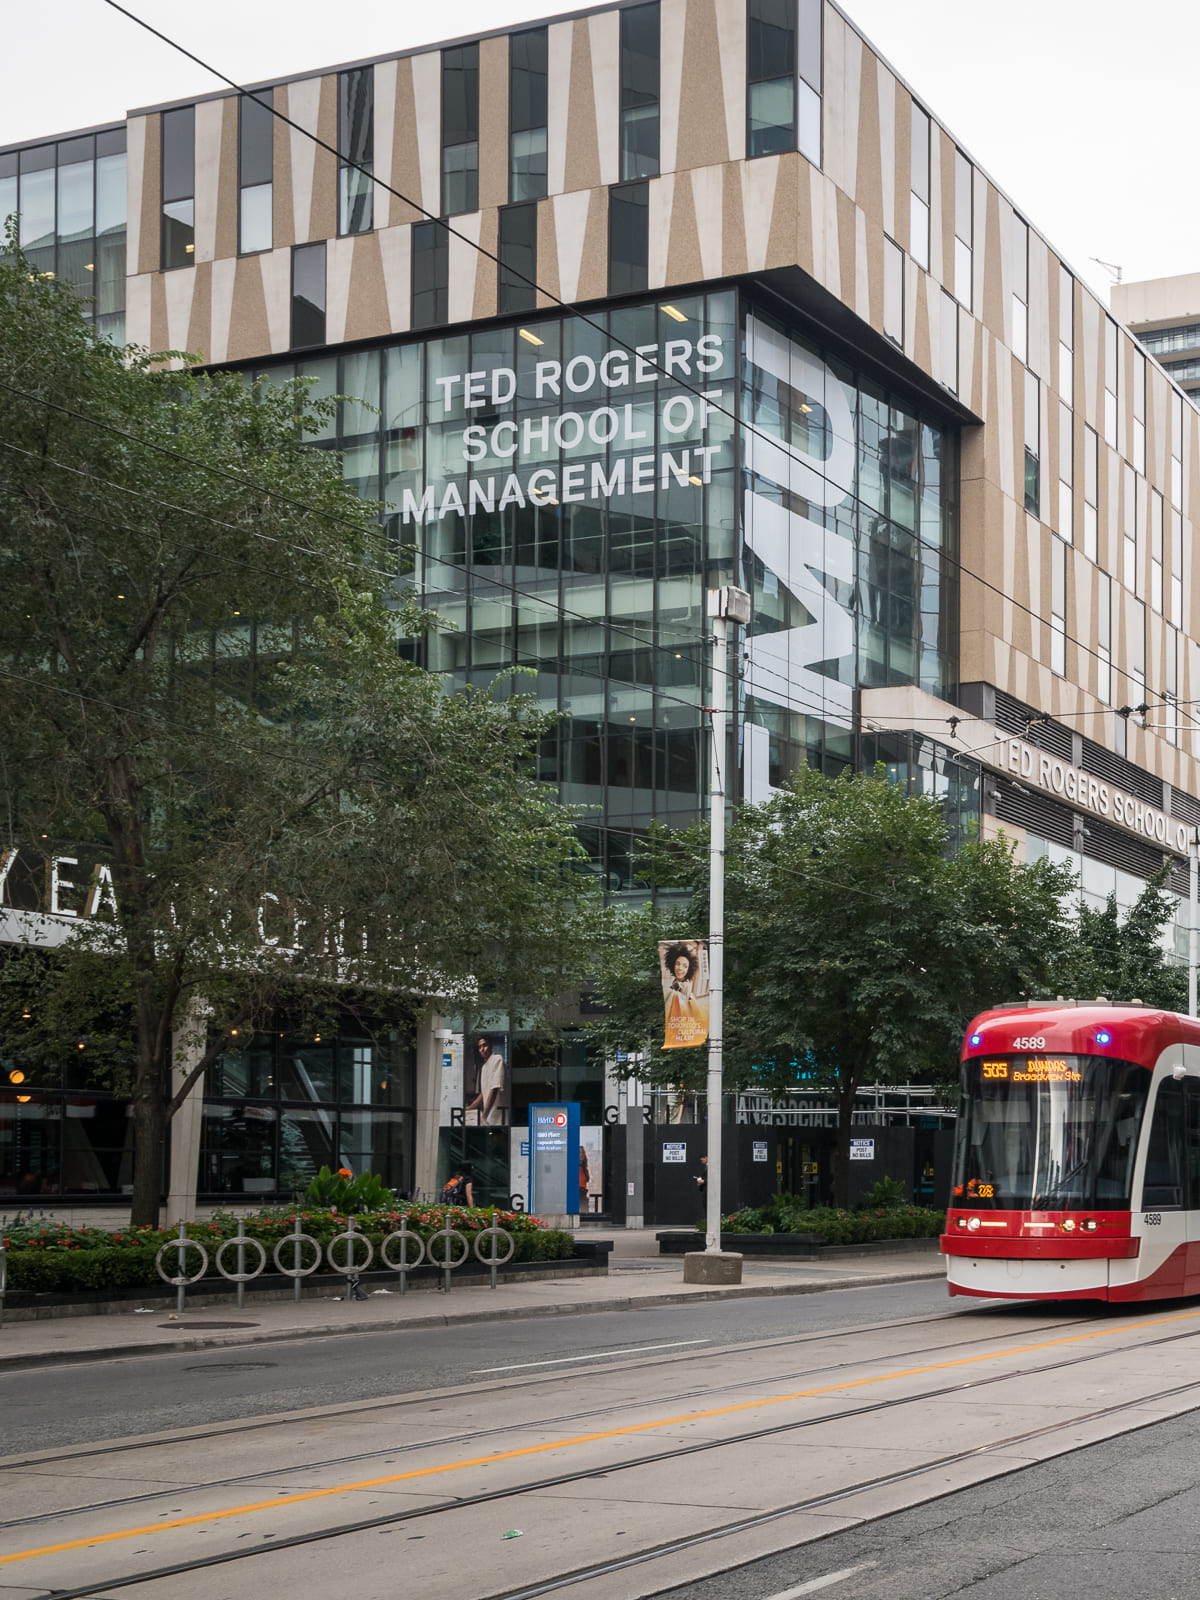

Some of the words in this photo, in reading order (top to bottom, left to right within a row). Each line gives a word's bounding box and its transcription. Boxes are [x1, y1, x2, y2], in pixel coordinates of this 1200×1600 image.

[435, 366, 517, 413] TED
[534, 333, 724, 400] ROGERS
[461, 402, 647, 463] SCHOOL
[662, 388, 723, 433] OF
[401, 445, 721, 526] MANAGEMENT
[994, 731, 1033, 779] TED
[1038, 752, 1110, 816] ROGERS
[1112, 791, 1173, 846] SCHOOL
[1013, 1037, 1046, 1050] 4589
[983, 1062, 1008, 1078] 505
[1013, 1071, 1063, 1081] Broadview
[1027, 1060, 1068, 1073] DUNDAS
[775, 1098, 833, 1128] SOCIAL
[1143, 1213, 1162, 1226] 4589
